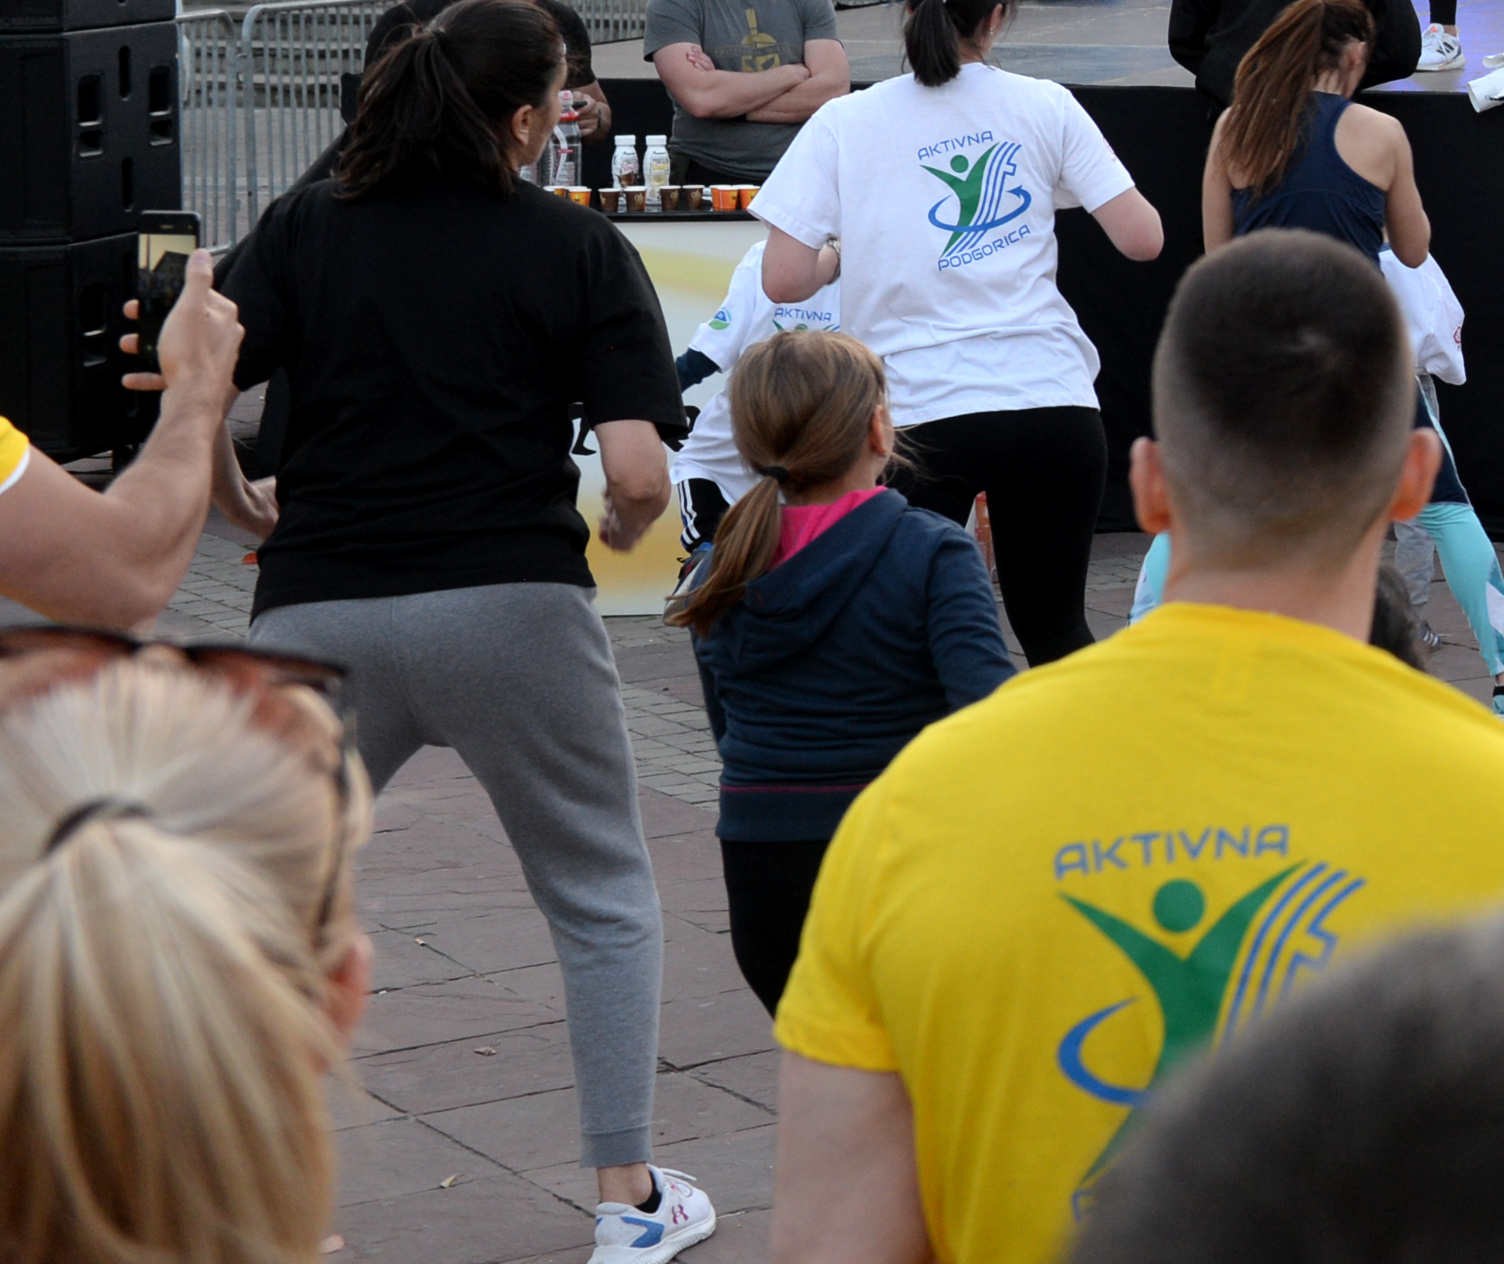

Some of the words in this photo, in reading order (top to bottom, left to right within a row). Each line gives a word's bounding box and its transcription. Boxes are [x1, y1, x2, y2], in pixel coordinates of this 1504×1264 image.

[917, 130, 994, 161] AKTIVNA
[937, 224, 1031, 272] PODGORICA
[774, 307, 832, 322] AKTIVNA
[1053, 823, 1290, 880] AKTIVNA
